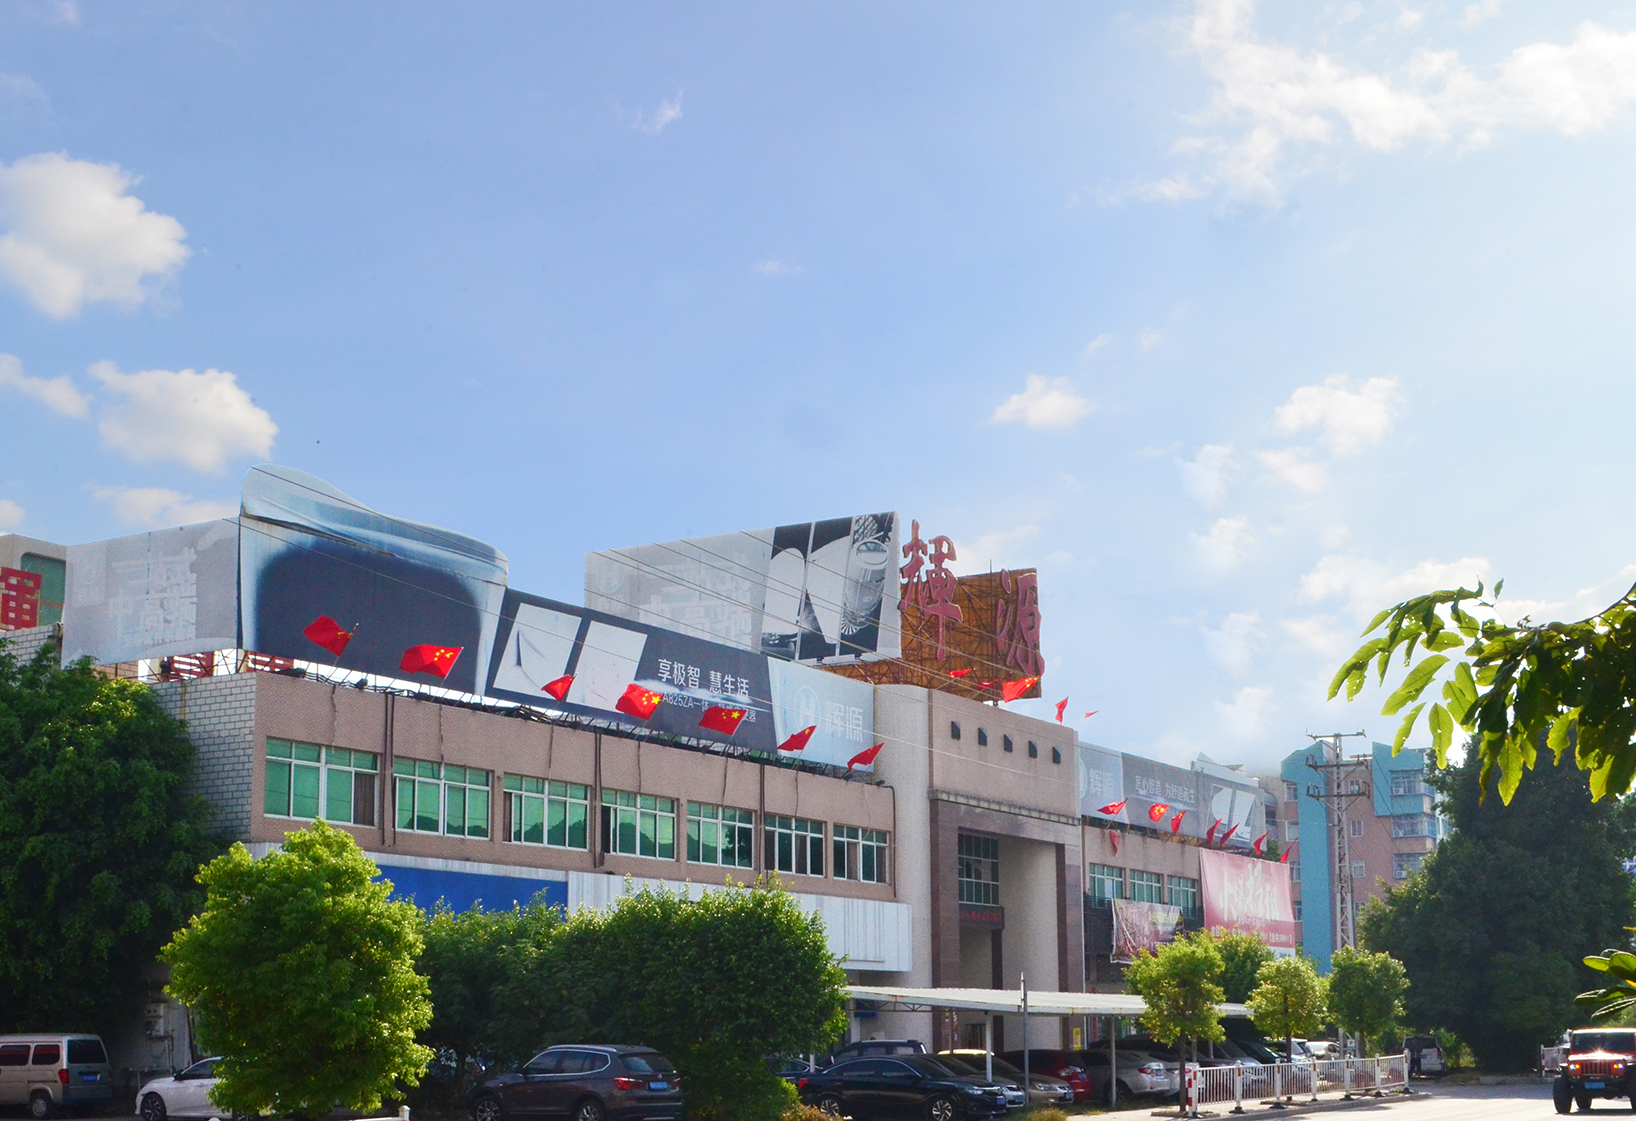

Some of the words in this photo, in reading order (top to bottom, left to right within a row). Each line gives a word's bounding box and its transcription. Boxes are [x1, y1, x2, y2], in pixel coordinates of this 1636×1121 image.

[657, 658, 700, 689] 享极智
[709, 670, 749, 697] 慧生活
[824, 701, 863, 742] 辉源
[1135, 775, 1162, 796] 匠心智造
